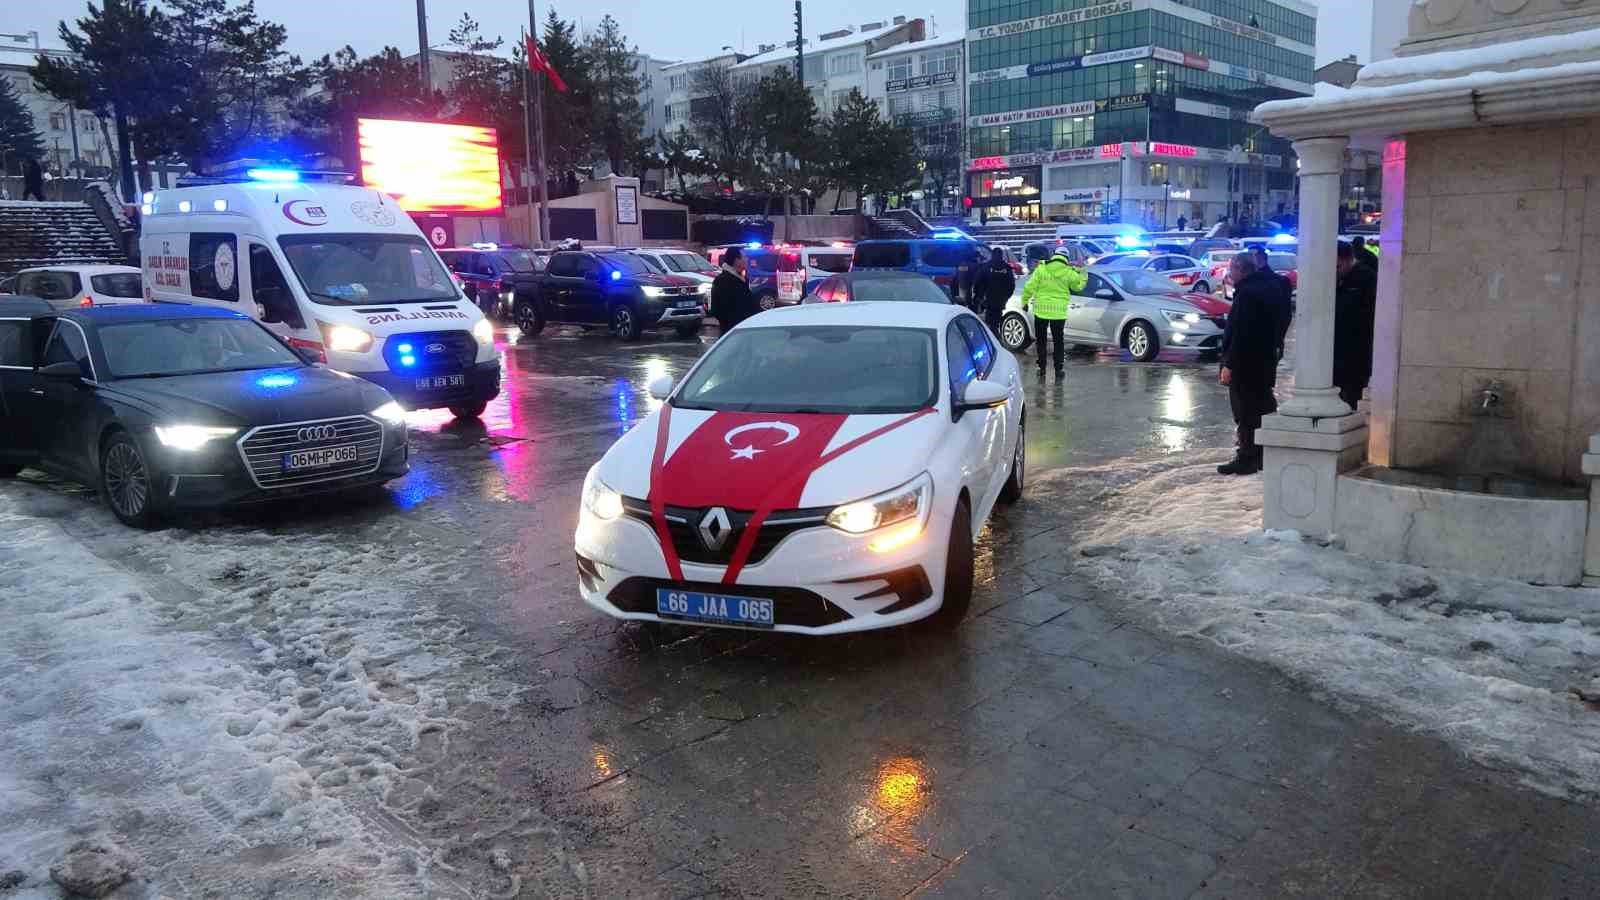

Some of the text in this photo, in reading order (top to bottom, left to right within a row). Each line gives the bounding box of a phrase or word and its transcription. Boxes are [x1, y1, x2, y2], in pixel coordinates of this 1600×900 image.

[979, 1, 1133, 38] T.C. YOZGAT TİCARET BORSASI
[1003, 111, 1023, 122] HATİP
[1026, 107, 1067, 119] MEZUNLARI
[1070, 103, 1093, 113] VAKFI
[668, 593, 688, 613] 66
[698, 596, 728, 617] JAA
[739, 599, 770, 620] 065
